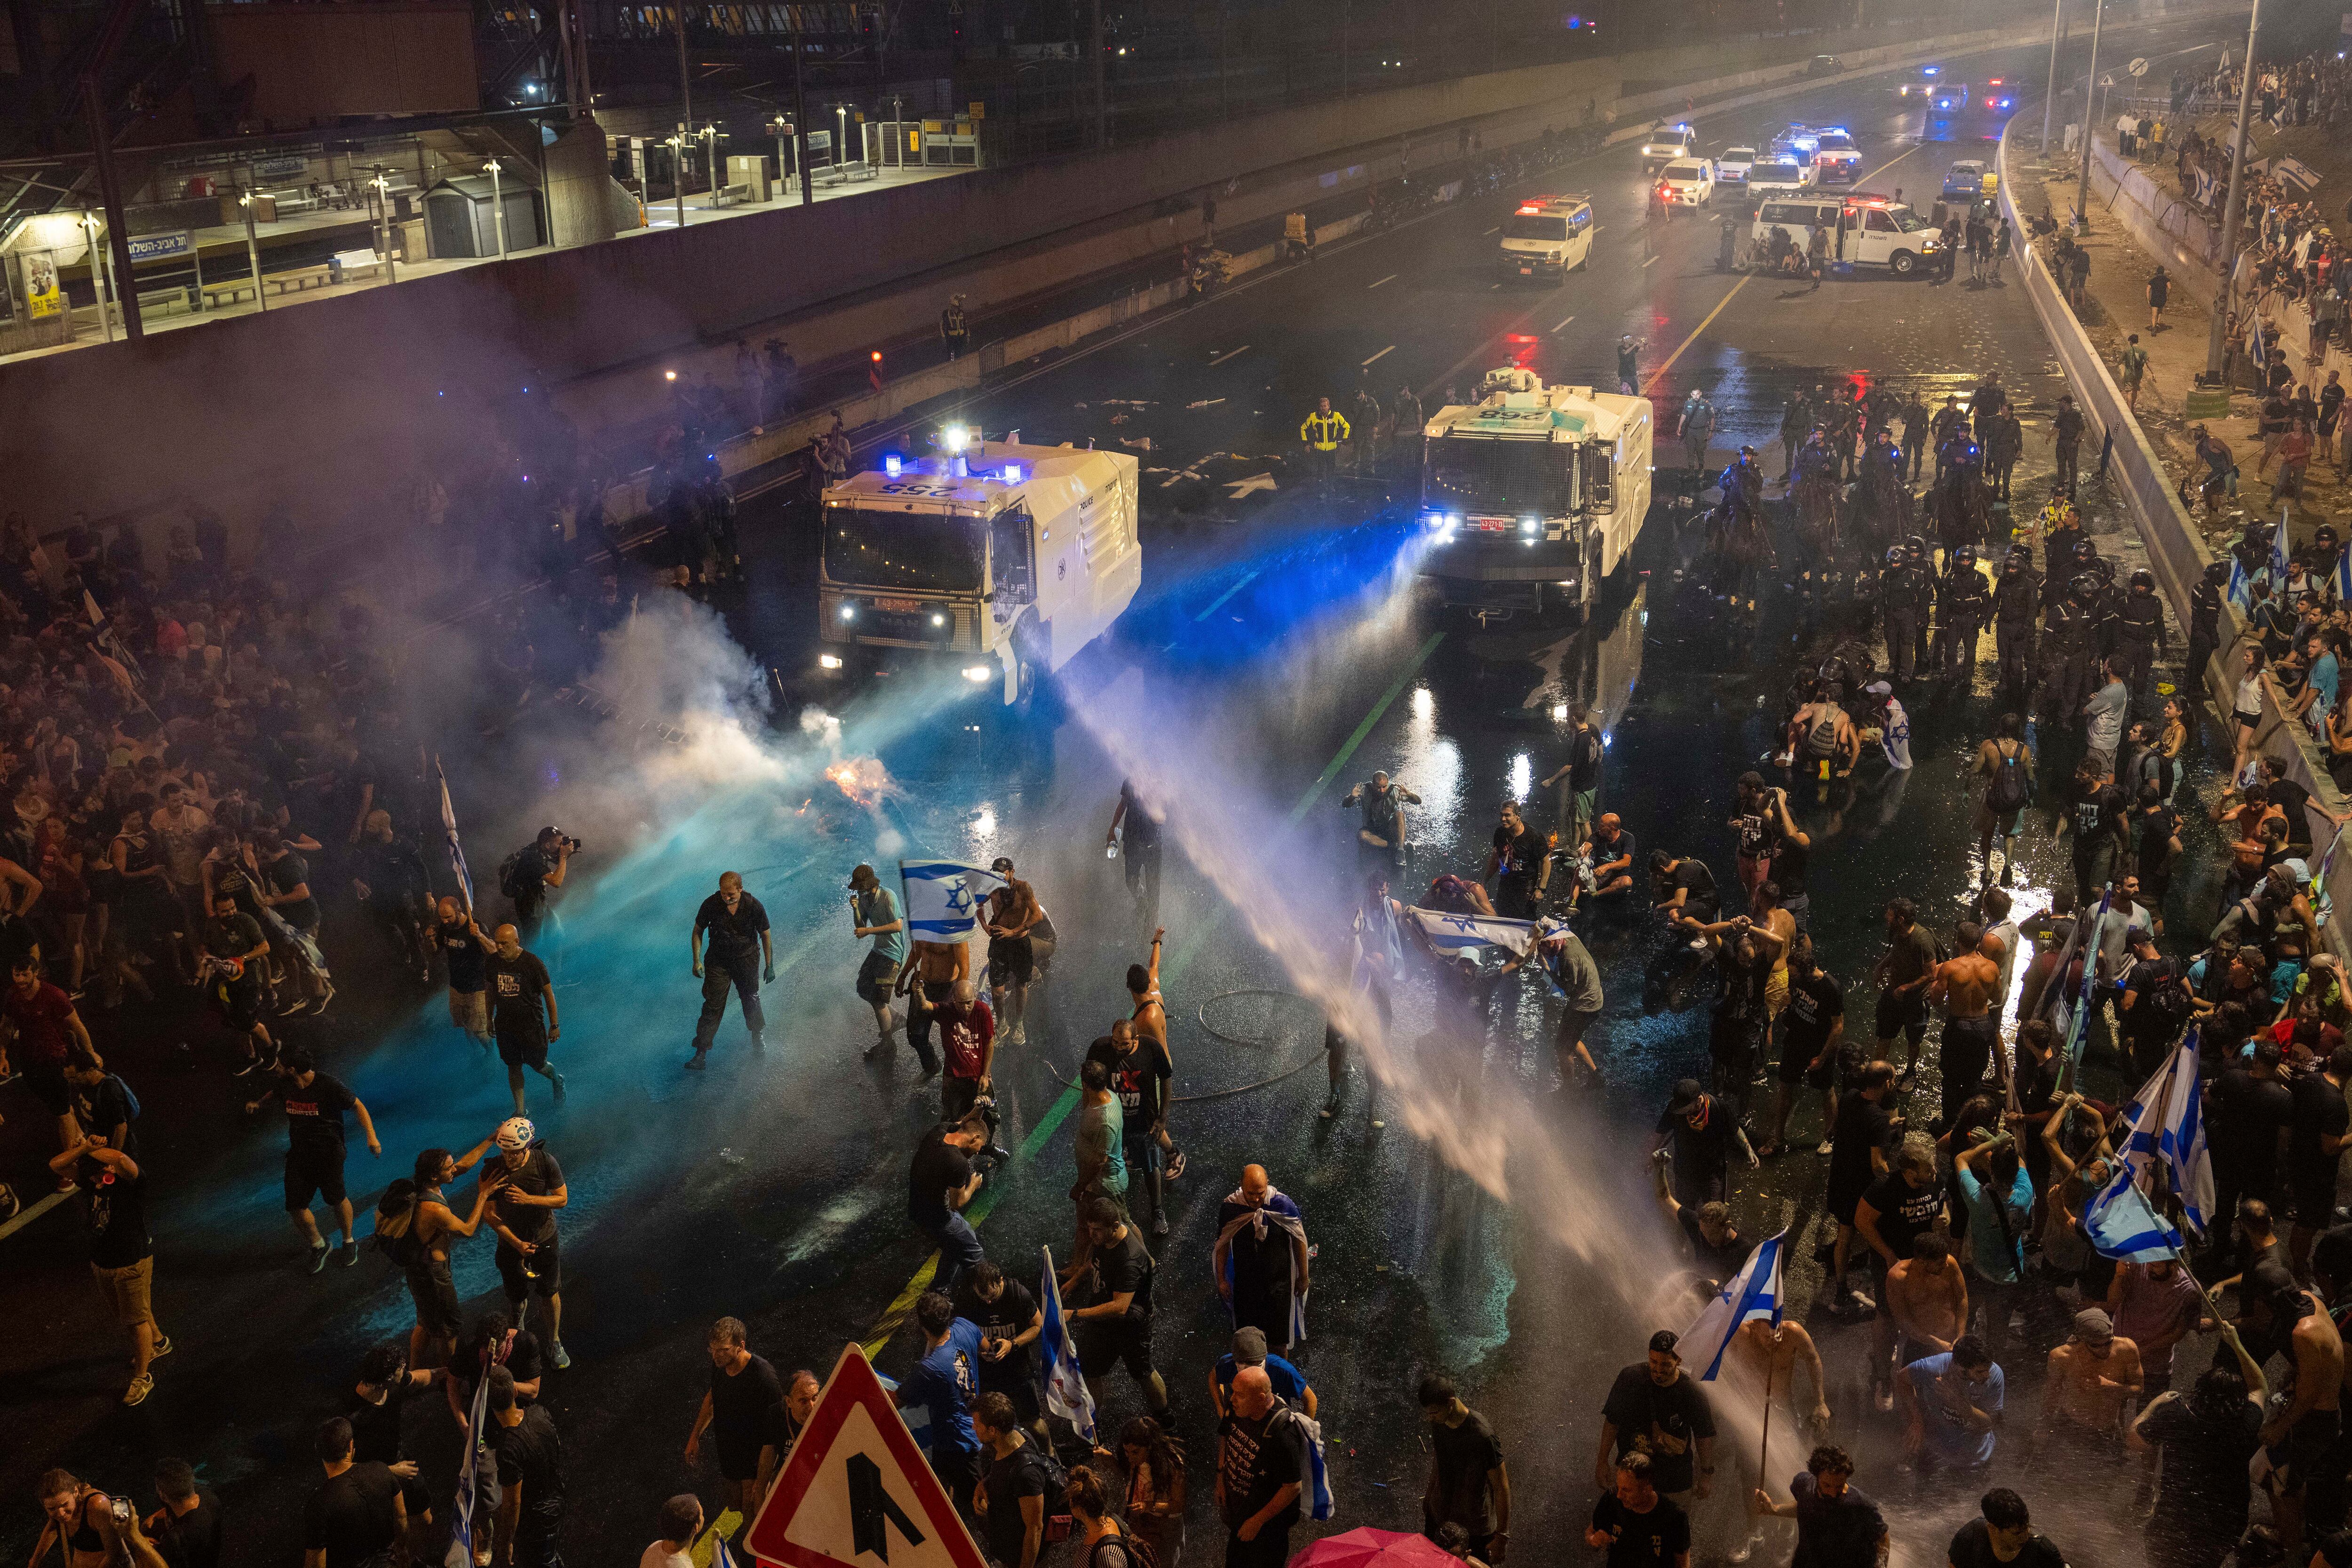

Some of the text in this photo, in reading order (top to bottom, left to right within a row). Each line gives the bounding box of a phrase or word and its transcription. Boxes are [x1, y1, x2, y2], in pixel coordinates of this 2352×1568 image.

[176, 236, 187, 247] תל
[1478, 410, 1545, 420] 268
[877, 483, 960, 497] 255
[1916, 1194, 1932, 1203] להיות
